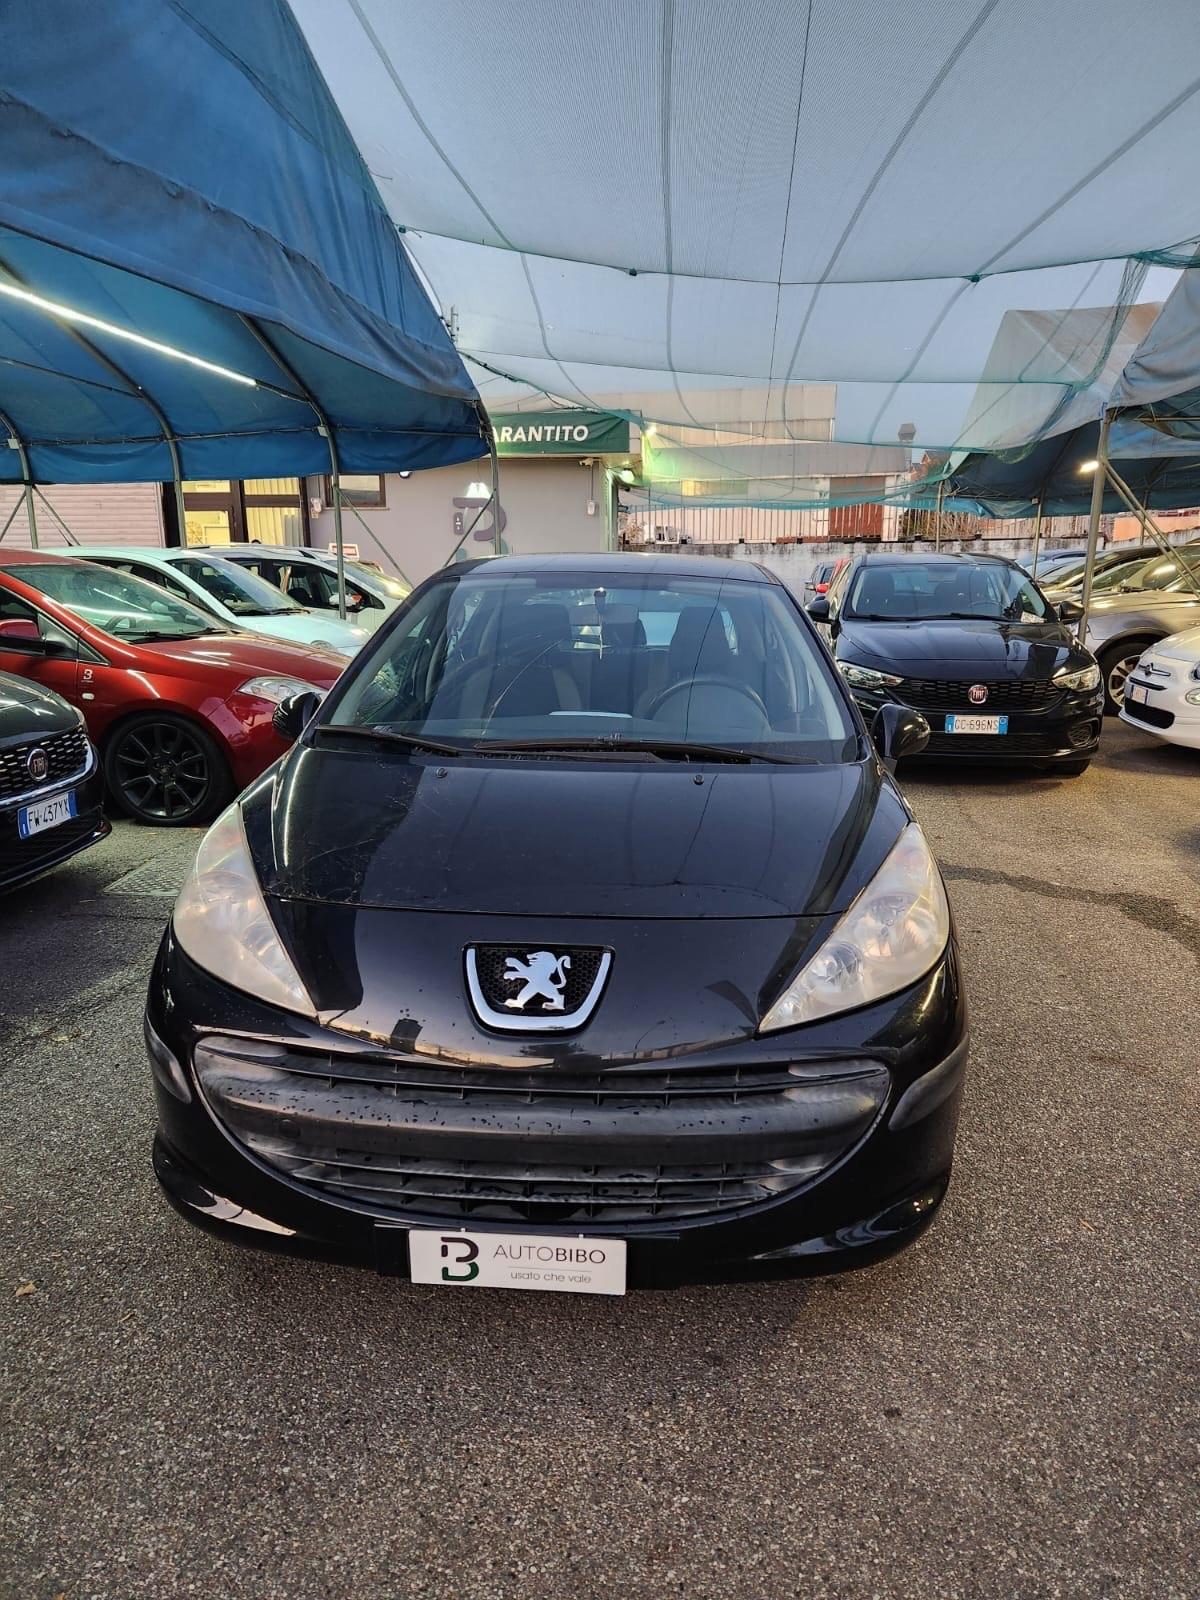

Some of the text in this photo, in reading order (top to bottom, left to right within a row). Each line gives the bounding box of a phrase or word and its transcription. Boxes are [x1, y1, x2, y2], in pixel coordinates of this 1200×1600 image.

[493, 1244, 606, 1264] AUTOBIBO
[511, 1271, 592, 1284] usato che vale
